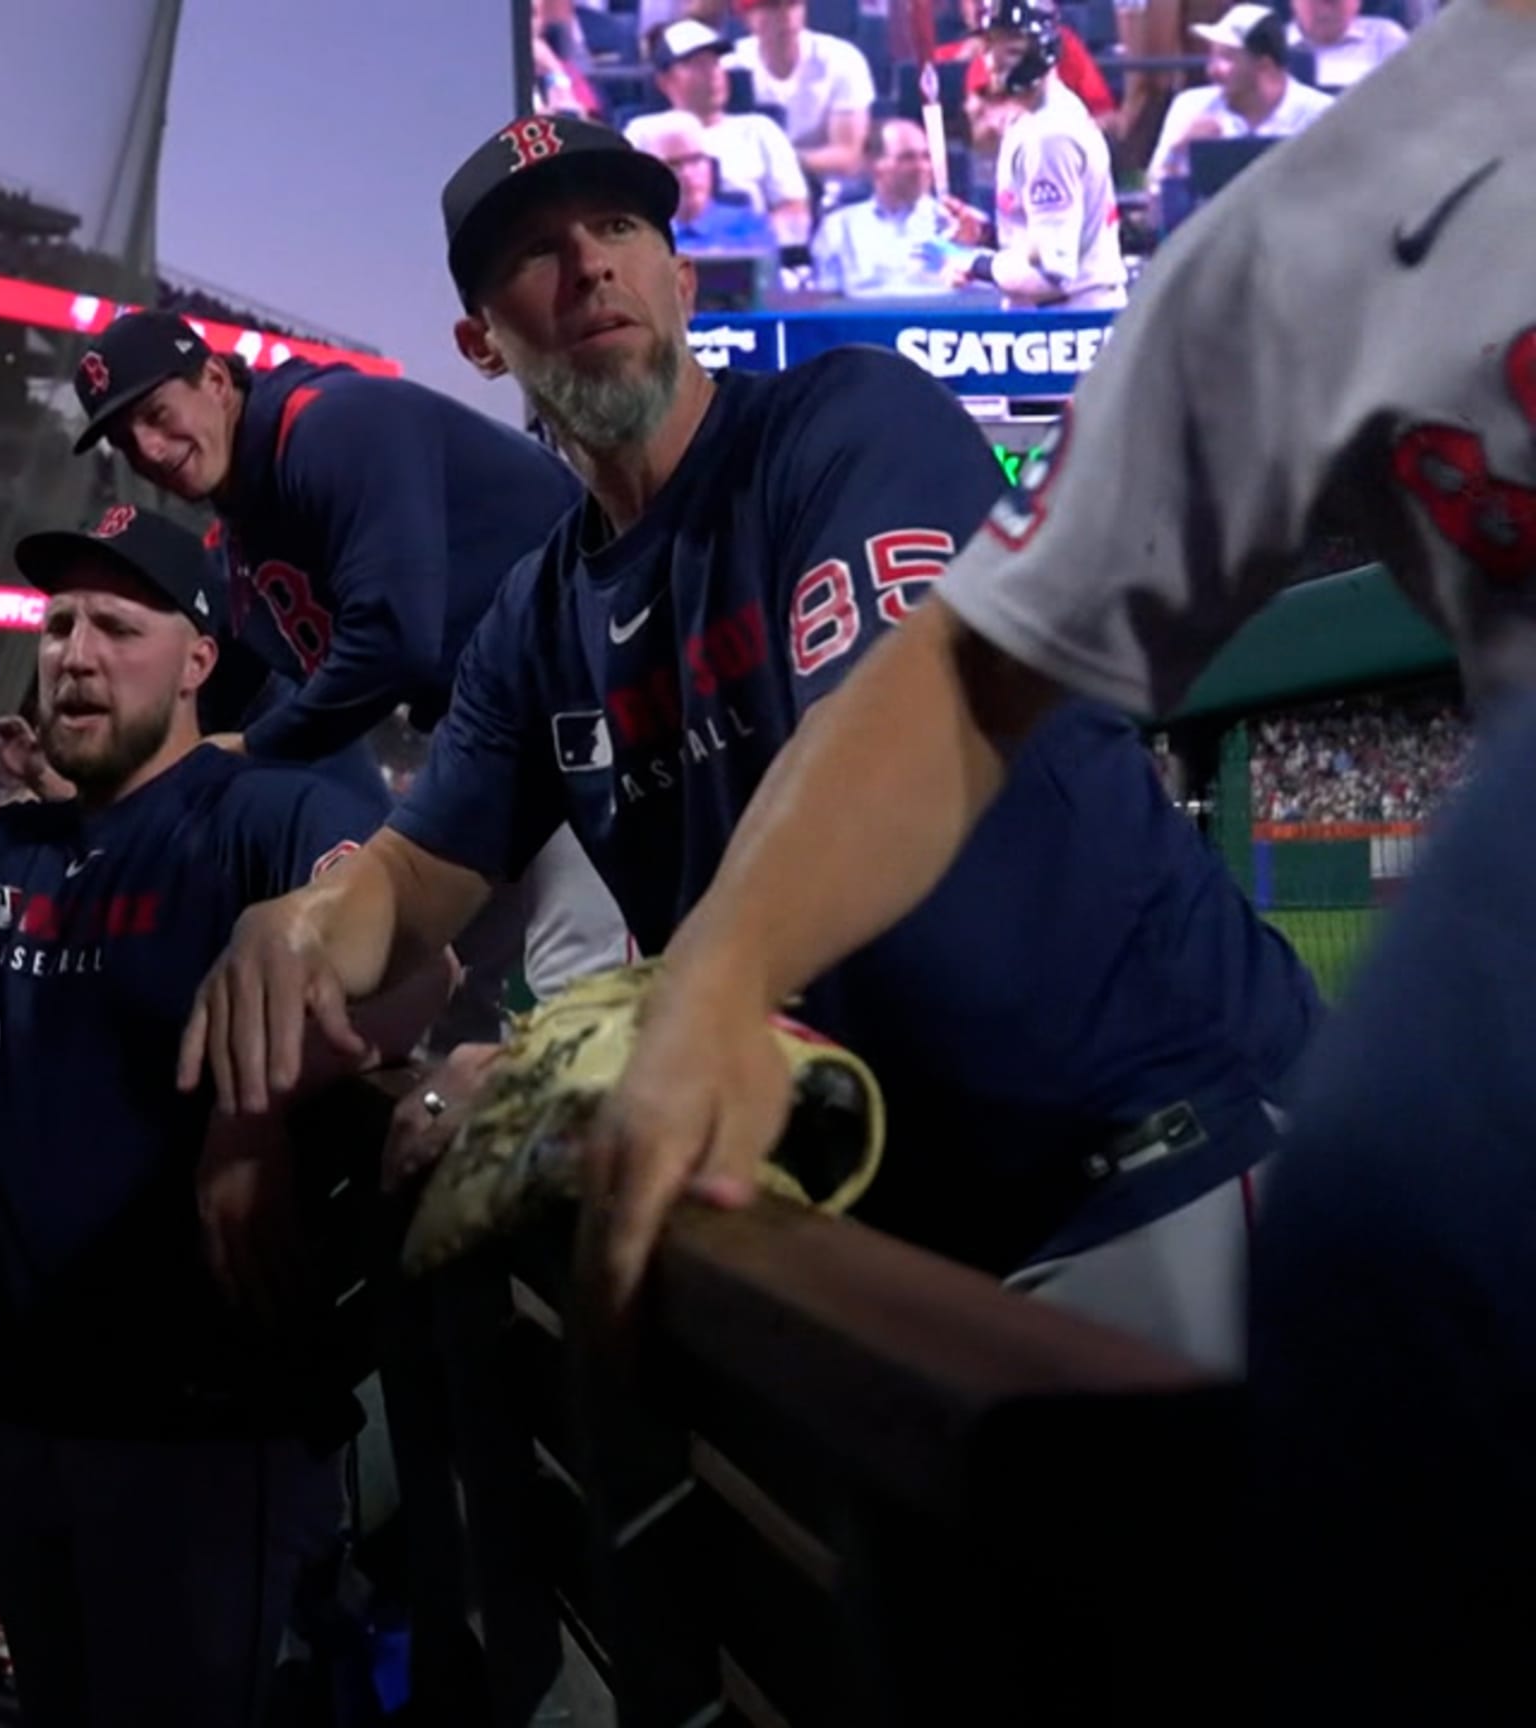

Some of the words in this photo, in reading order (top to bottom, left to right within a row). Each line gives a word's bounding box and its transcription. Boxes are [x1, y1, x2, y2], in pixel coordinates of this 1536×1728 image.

[499, 115, 565, 174] B
[896, 326, 1114, 377] SEATGEE
[789, 528, 956, 677] 85
